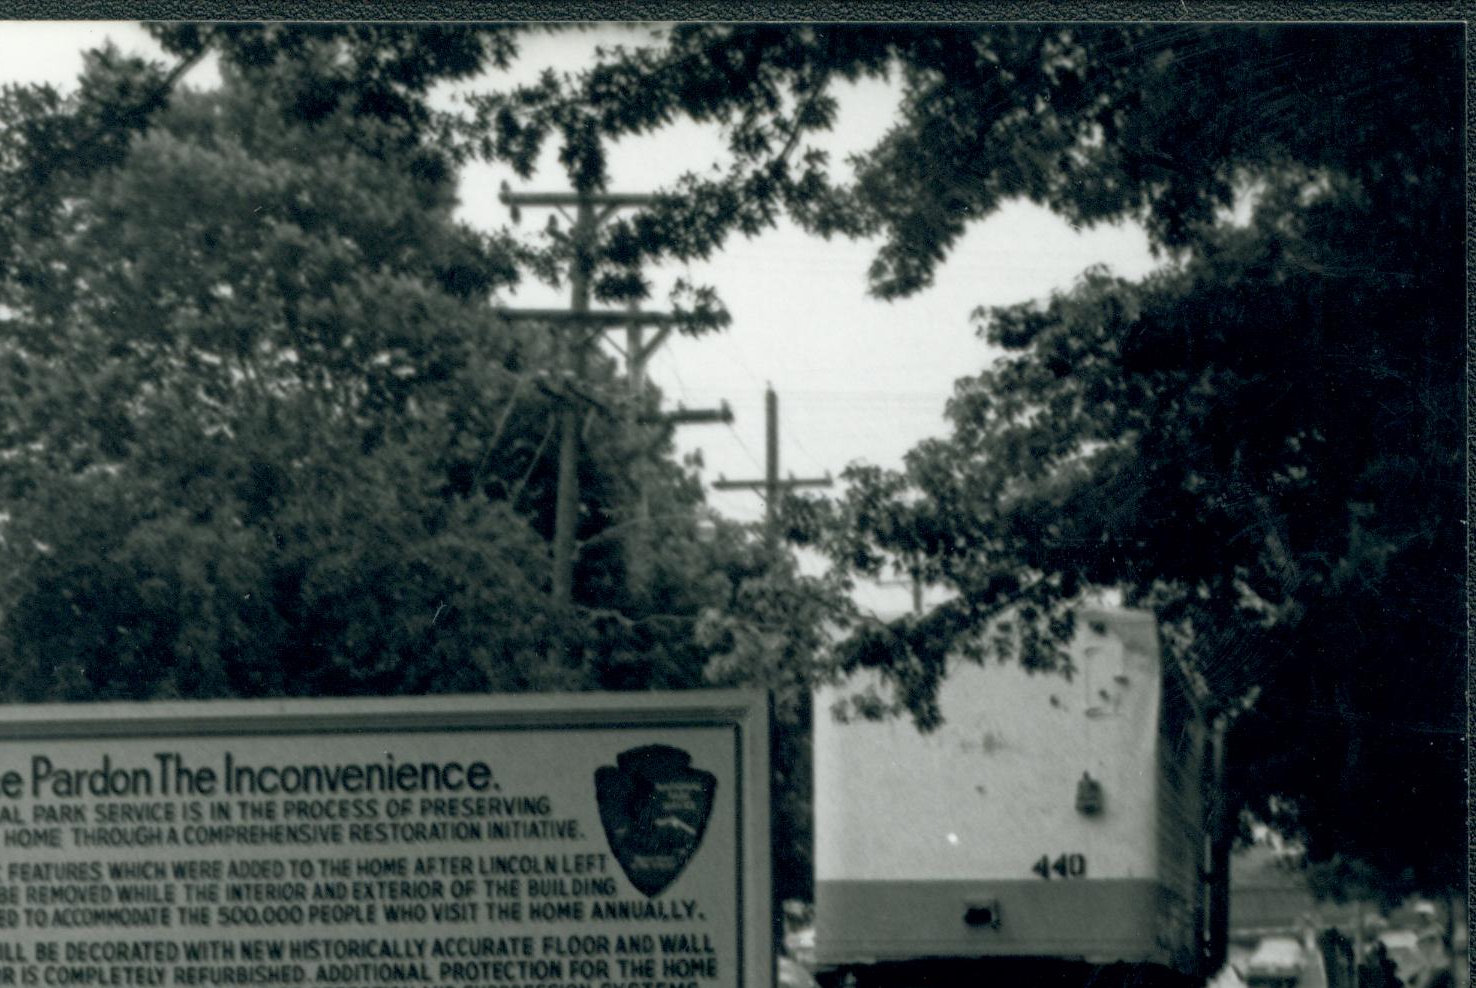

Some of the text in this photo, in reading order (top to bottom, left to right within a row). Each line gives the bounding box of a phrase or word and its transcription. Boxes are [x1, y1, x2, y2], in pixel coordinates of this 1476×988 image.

[31, 754, 153, 799] Pardon
[153, 752, 217, 797] The
[224, 751, 502, 795] Inconvenience.
[33, 804, 86, 825] PARK
[94, 802, 175, 824] SERVICE
[210, 801, 230, 822] IN
[238, 800, 276, 821] THE
[283, 798, 378, 820] PROCESS
[386, 798, 412, 819] OF
[421, 795, 551, 818] PRESERVING
[5, 827, 64, 848] HOME
[71, 826, 163, 847] THROUGH
[183, 823, 342, 846] COMPREHENSIVE
[350, 821, 481, 843] RESTORATION
[487, 819, 585, 841] INITIATIVE.
[8, 861, 103, 882] FEATURES
[107, 860, 166, 881] WHICH
[171, 859, 222, 880] WERE
[228, 858, 284, 880] ADDED
[289, 858, 314, 879] TO
[318, 857, 352, 878] THE
[357, 857, 408, 878] HOME
[414, 856, 475, 877] AFTER
[479, 854, 559, 876] LINCOLN
[562, 854, 607, 875] LEFT
[1032, 853, 1087, 879] 440
[26, 884, 113, 905] REMOVED
[116, 883, 176, 903] WHILE
[184, 883, 219, 903] THE
[226, 882, 307, 902] INTERIOR
[312, 881, 348, 901] AND
[352, 880, 445, 901] EXTERIOR
[450, 879, 476, 900] OF
[484, 879, 520, 899] THE
[528, 878, 617, 899] BUILDING
[24, 908, 49, 928] TO
[52, 906, 171, 928] ACCOMMODATE
[177, 906, 211, 927] THE
[308, 904, 376, 925] PEOPLE
[383, 903, 427, 924] WHO
[431, 902, 479, 923] VISIT
[485, 902, 522, 923] THE
[528, 901, 584, 922] HOME
[590, 900, 706, 921] ANNUALLY.
[36, 941, 59, 961] BE
[65, 940, 180, 961] DECORATED
[182, 939, 235, 960] WITH
[241, 939, 285, 960] NEW
[289, 938, 427, 959] HISTORICALLY
[430, 936, 533, 958] ACCURATE
[542, 936, 611, 957] FLOOR
[615, 935, 656, 956] AND
[659, 935, 715, 956] WALL
[44, 964, 167, 984] COMPLETELY
[315, 962, 432, 983] ADDITIONAL
[439, 961, 563, 982] PROTECTION
[568, 960, 610, 981] FOR
[616, 960, 656, 981] THE
[662, 959, 718, 980] HOME
